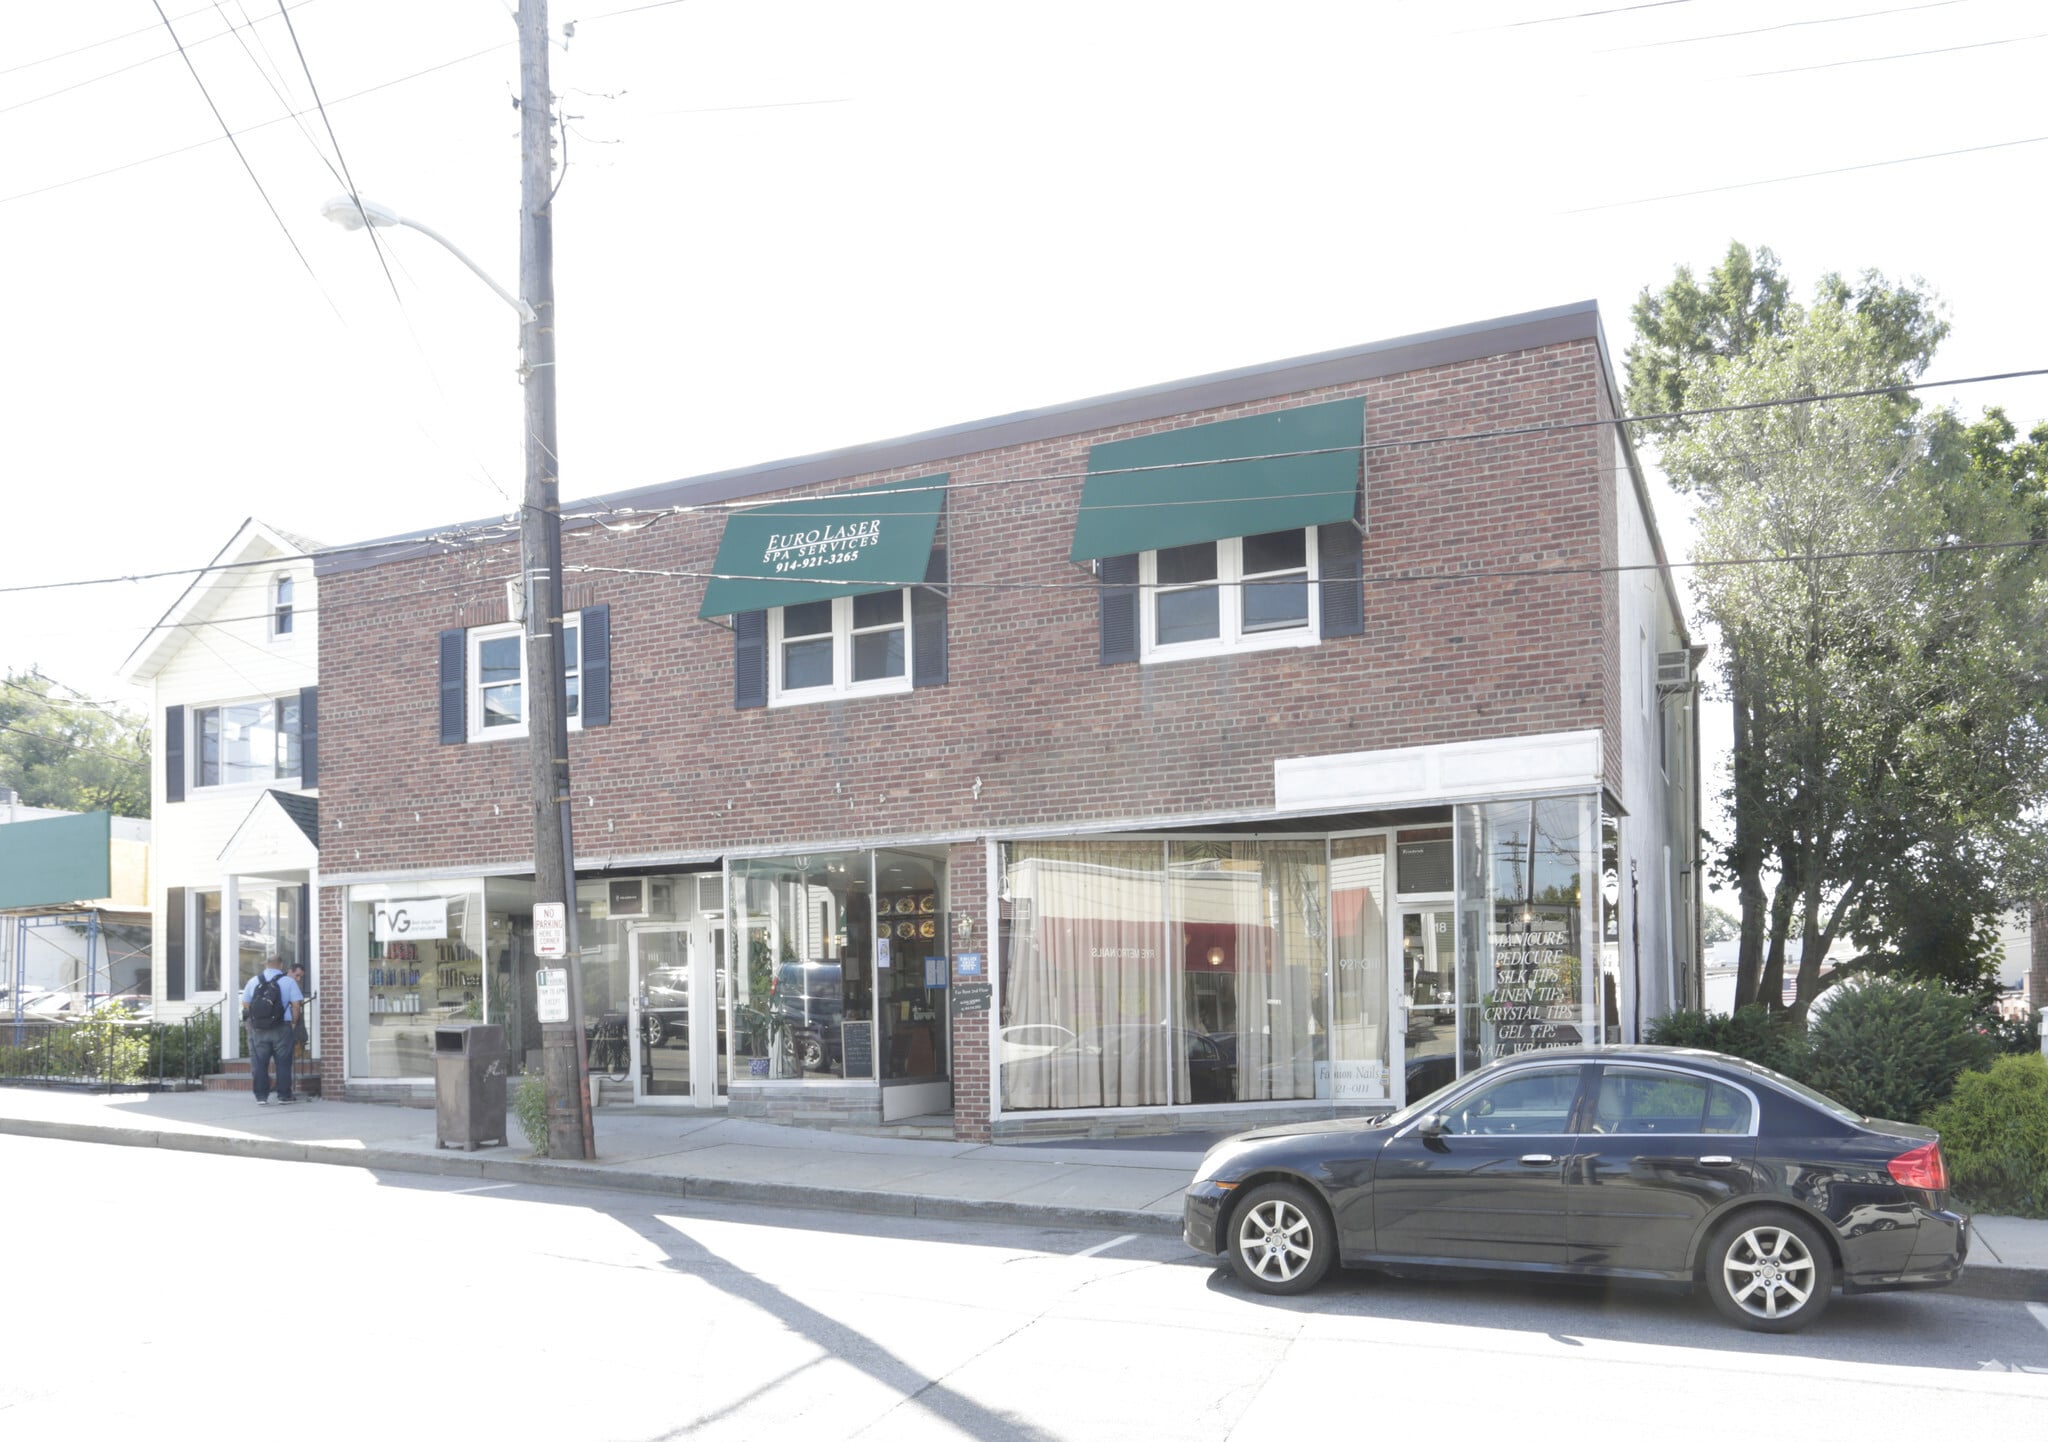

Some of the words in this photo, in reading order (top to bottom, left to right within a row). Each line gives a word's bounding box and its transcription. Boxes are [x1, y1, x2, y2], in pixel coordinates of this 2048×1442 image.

[763, 550, 790, 563] SPA
[798, 535, 879, 557] SERVICES
[776, 551, 859, 573] 914-921-3265
[543, 909, 555, 919] NO
[535, 919, 563, 929] PARKING
[1495, 931, 1568, 947] MANICURE
[1496, 949, 1563, 966] PEDICURE
[1498, 969, 1528, 984] SILK
[1531, 967, 1560, 983] TIPS
[1492, 987, 1534, 1003] LINEN
[1537, 986, 1565, 1002] TIPS
[1484, 1005, 1541, 1021] CRYSTAL
[1545, 1004, 1575, 1020] TIPS
[1499, 1024, 1526, 1039] GEL
[1529, 1023, 1559, 1039] TIPS
[1475, 1042, 1506, 1057] NAIL
[1356, 1064, 1381, 1079] Nails
